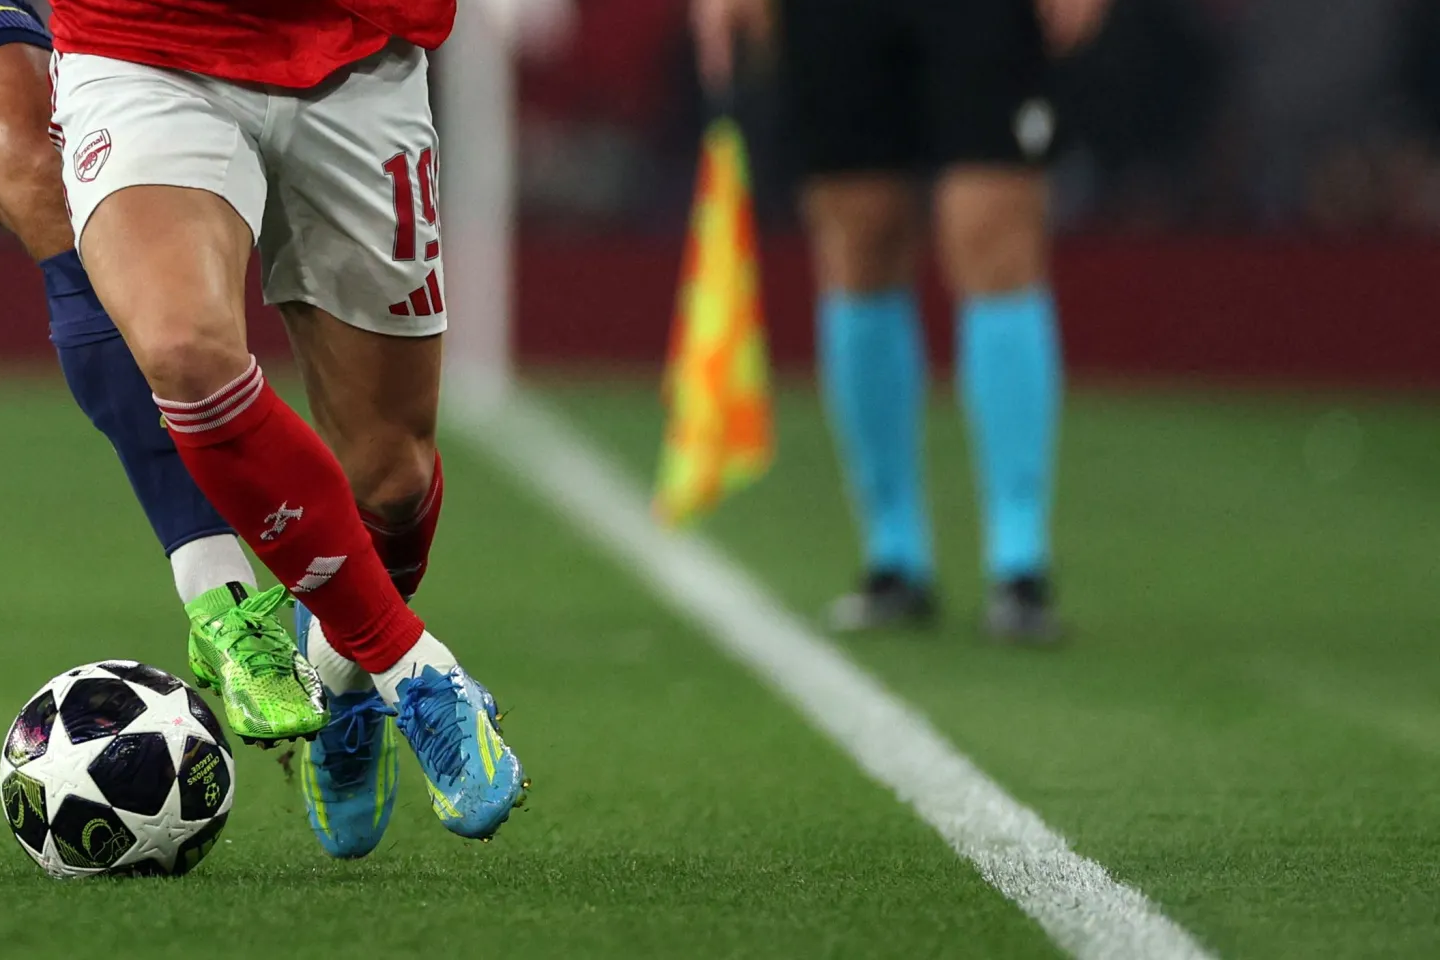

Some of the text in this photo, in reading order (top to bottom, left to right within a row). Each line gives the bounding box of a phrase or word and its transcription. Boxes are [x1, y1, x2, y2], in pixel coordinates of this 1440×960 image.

[381, 147, 440, 261] 19
[187, 756, 220, 785] CHAMPIONS
[191, 753, 213, 774] LEAGUE
